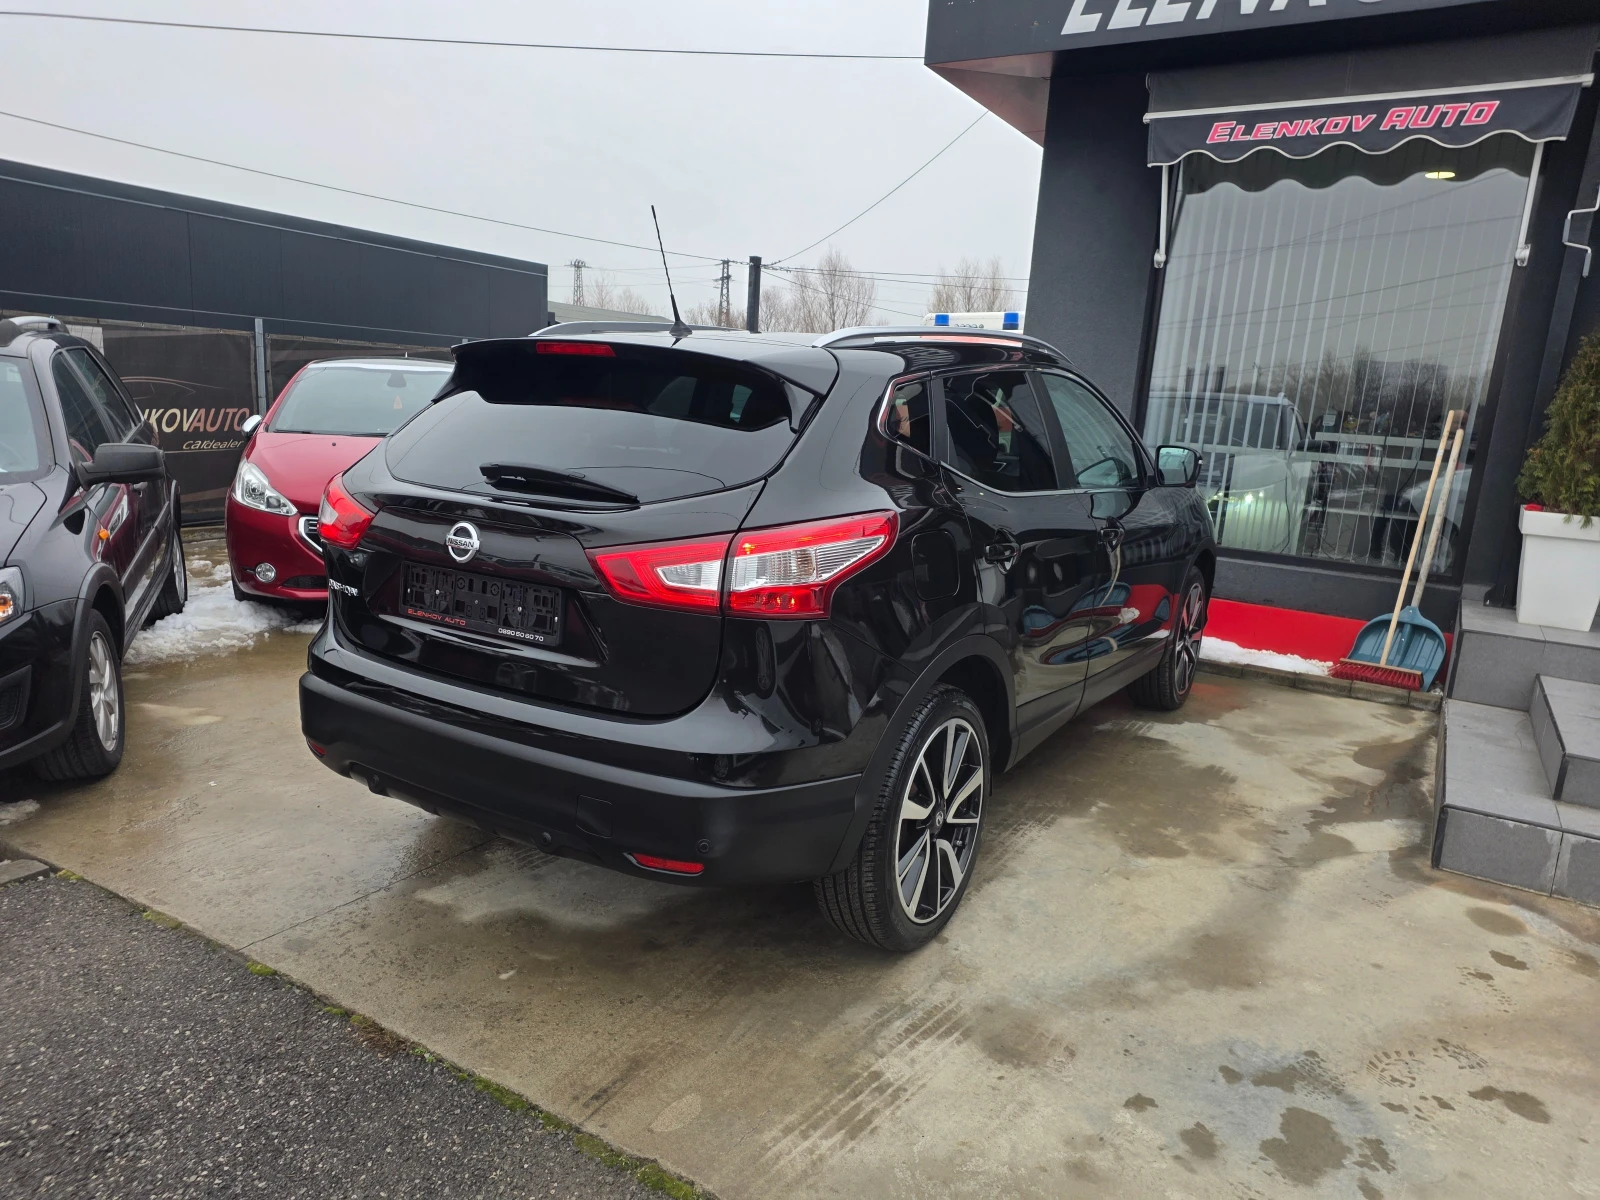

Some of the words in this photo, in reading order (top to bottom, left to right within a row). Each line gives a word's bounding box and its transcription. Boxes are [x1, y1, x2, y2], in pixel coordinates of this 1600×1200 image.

[1379, 100, 1500, 130] AUTO
[447, 537, 475, 549] NISSAN
[444, 616, 466, 626] AUTO
